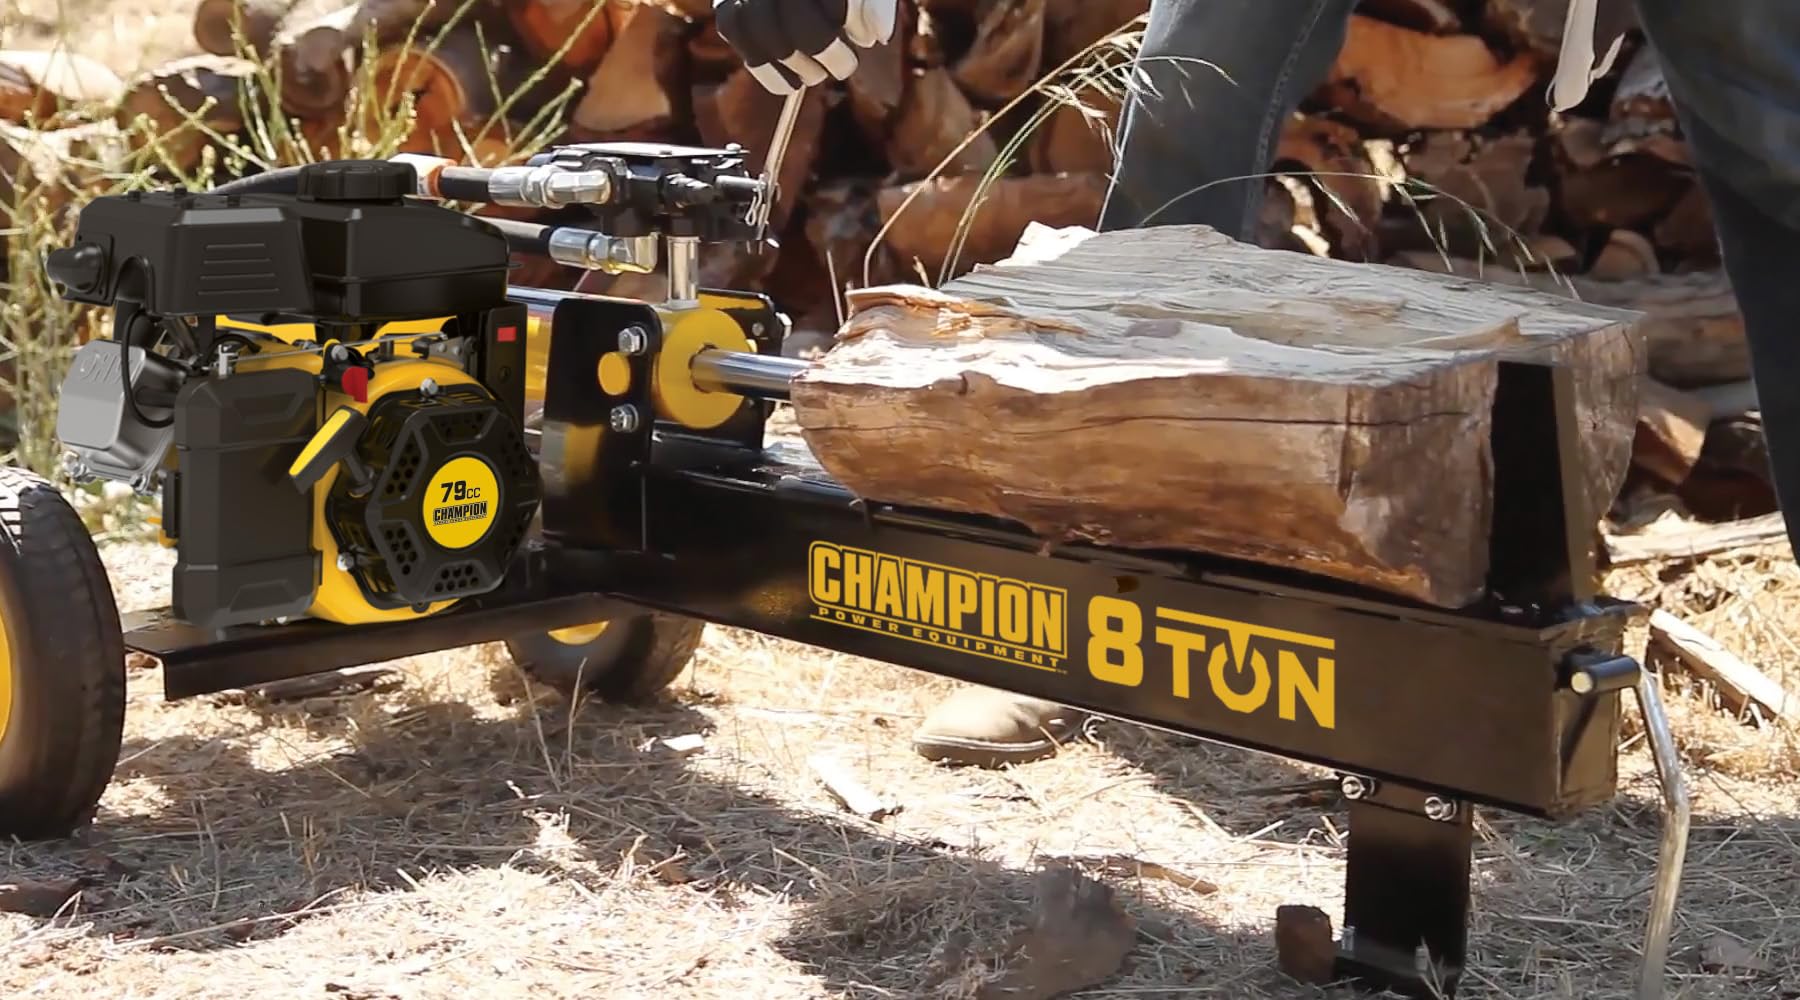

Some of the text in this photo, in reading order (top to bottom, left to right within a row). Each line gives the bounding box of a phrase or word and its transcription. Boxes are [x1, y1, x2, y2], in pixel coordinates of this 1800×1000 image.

[434, 502, 487, 521] CHAMPION
[813, 546, 1062, 652] CHAMPION
[819, 606, 1059, 668] POWER EQUIPMENT
[1087, 595, 1335, 729] 8 TON
